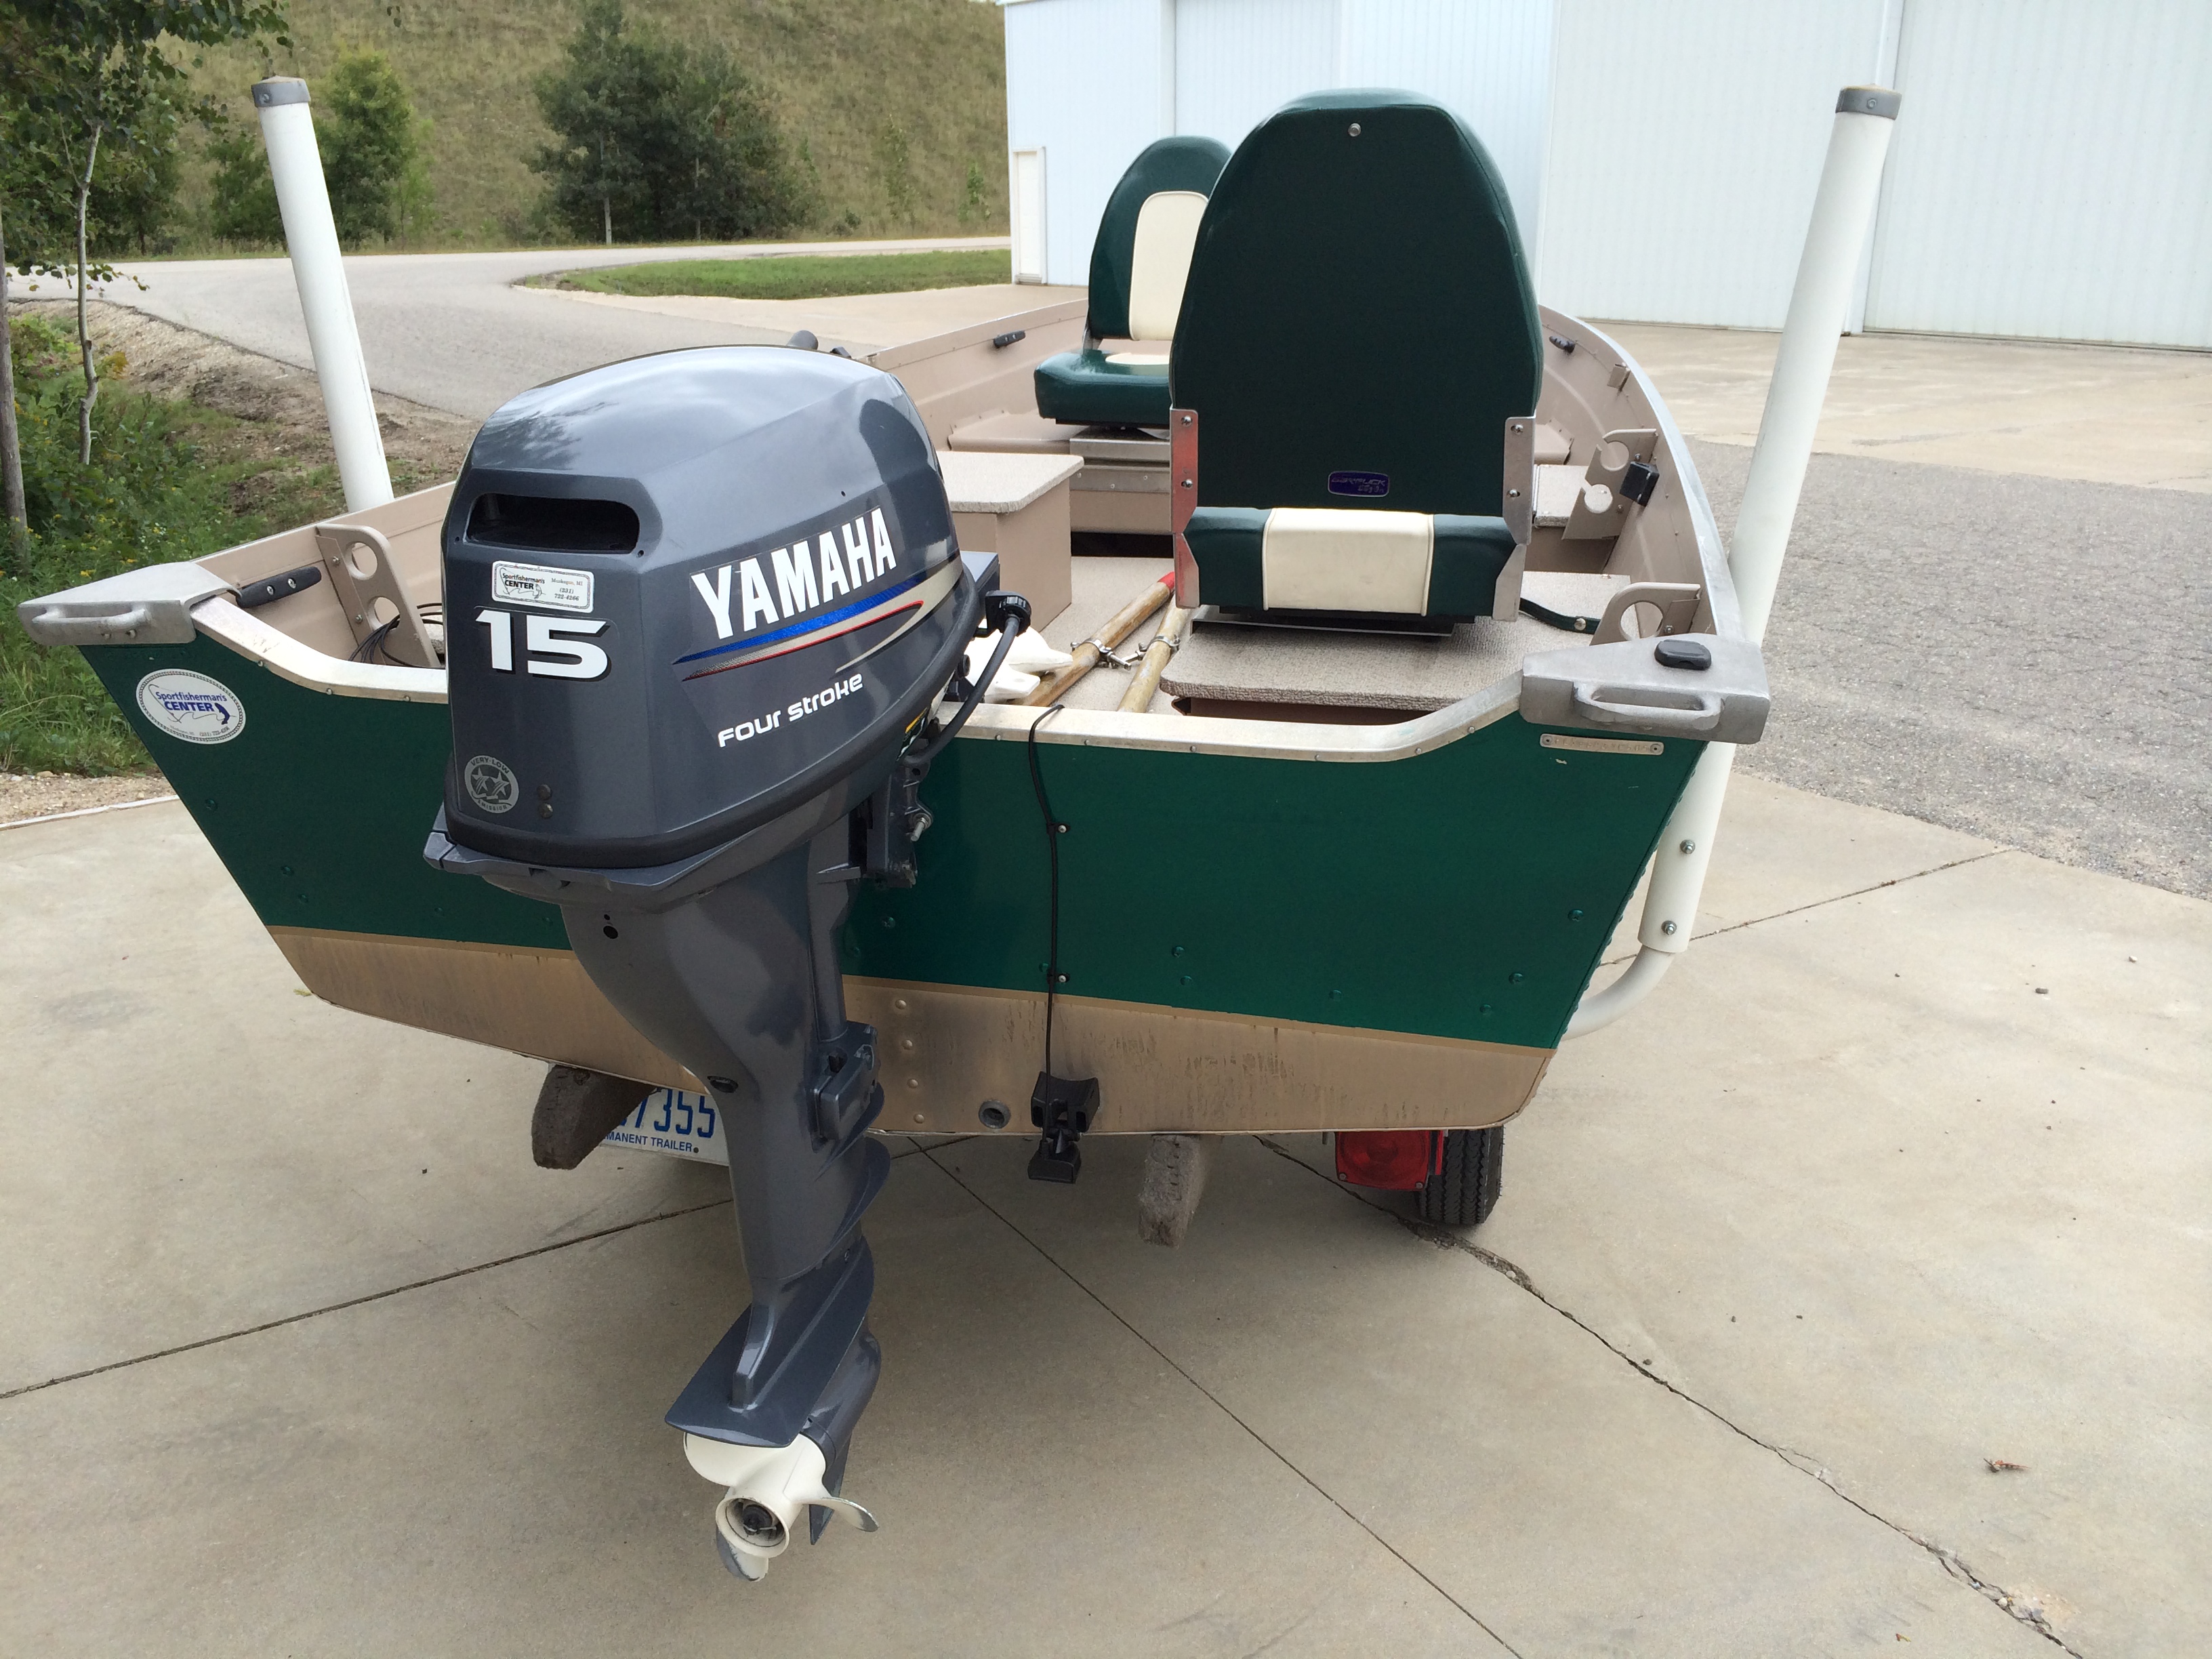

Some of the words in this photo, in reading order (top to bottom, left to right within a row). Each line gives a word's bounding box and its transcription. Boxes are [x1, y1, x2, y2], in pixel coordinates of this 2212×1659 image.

[691, 508, 897, 640] YAMAHA
[504, 580, 534, 590] CENTER
[475, 609, 610, 681] 15
[155, 691, 228, 702] Sportfisherman's
[164, 701, 215, 712] CENTER
[470, 756, 489, 766] VERY
[491, 758, 510, 774] LOW
[651, 1136, 693, 1152] TRAILER
